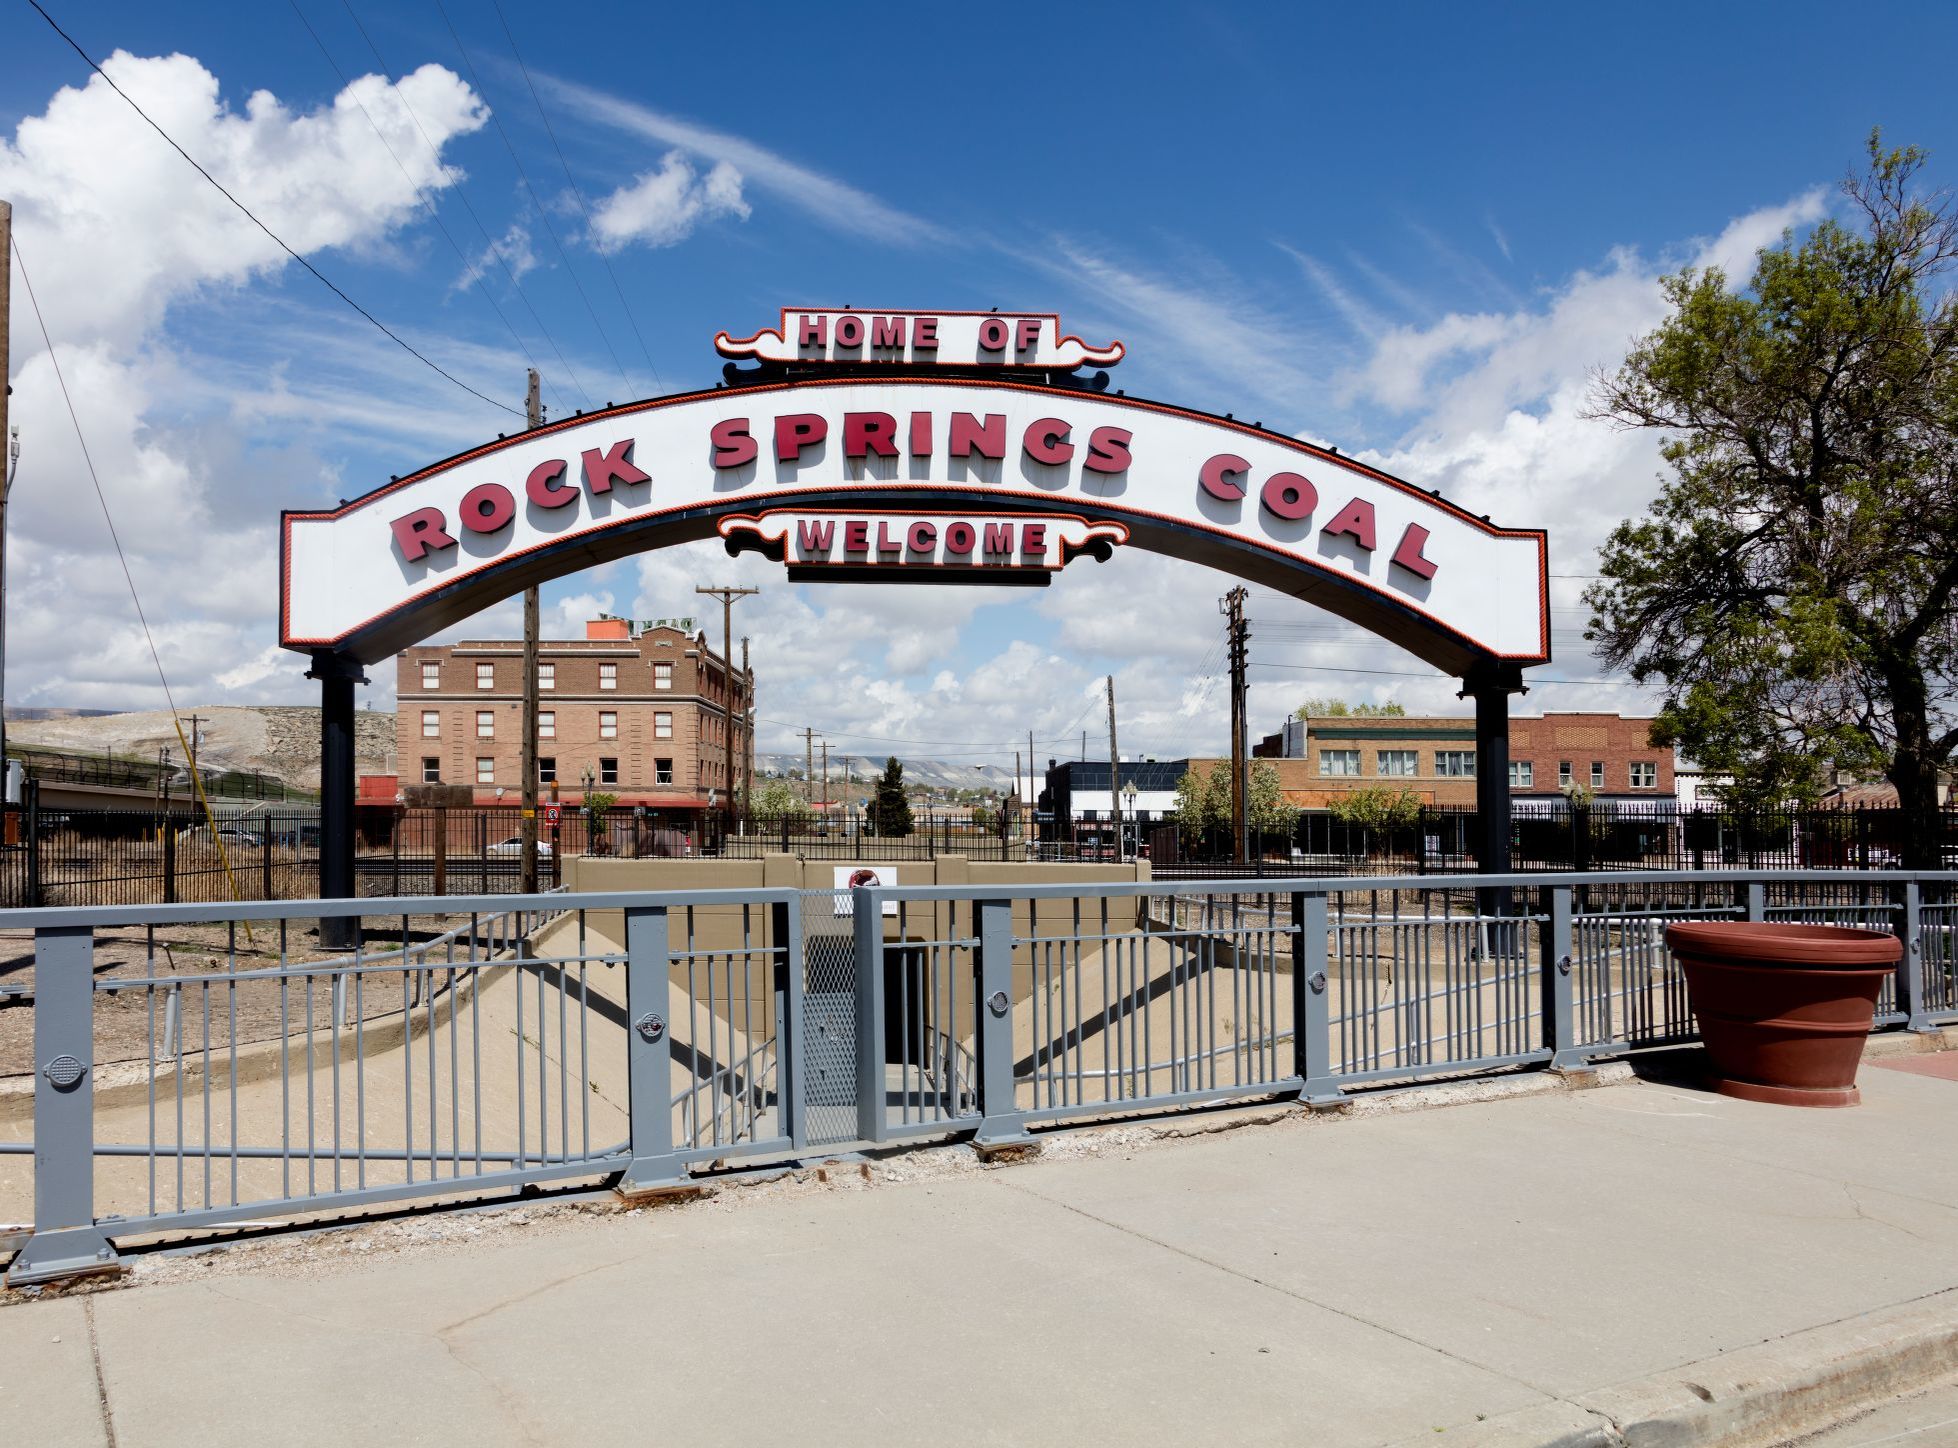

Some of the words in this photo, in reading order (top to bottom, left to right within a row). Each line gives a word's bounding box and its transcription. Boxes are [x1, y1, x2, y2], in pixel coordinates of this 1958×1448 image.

[799, 314, 940, 350] HOME
[979, 318, 1042, 352] OF
[390, 438, 653, 563] ROCK
[711, 411, 1133, 475] SPRINGS
[1199, 453, 1439, 582] COAL
[797, 519, 1047, 555] WELCOME
